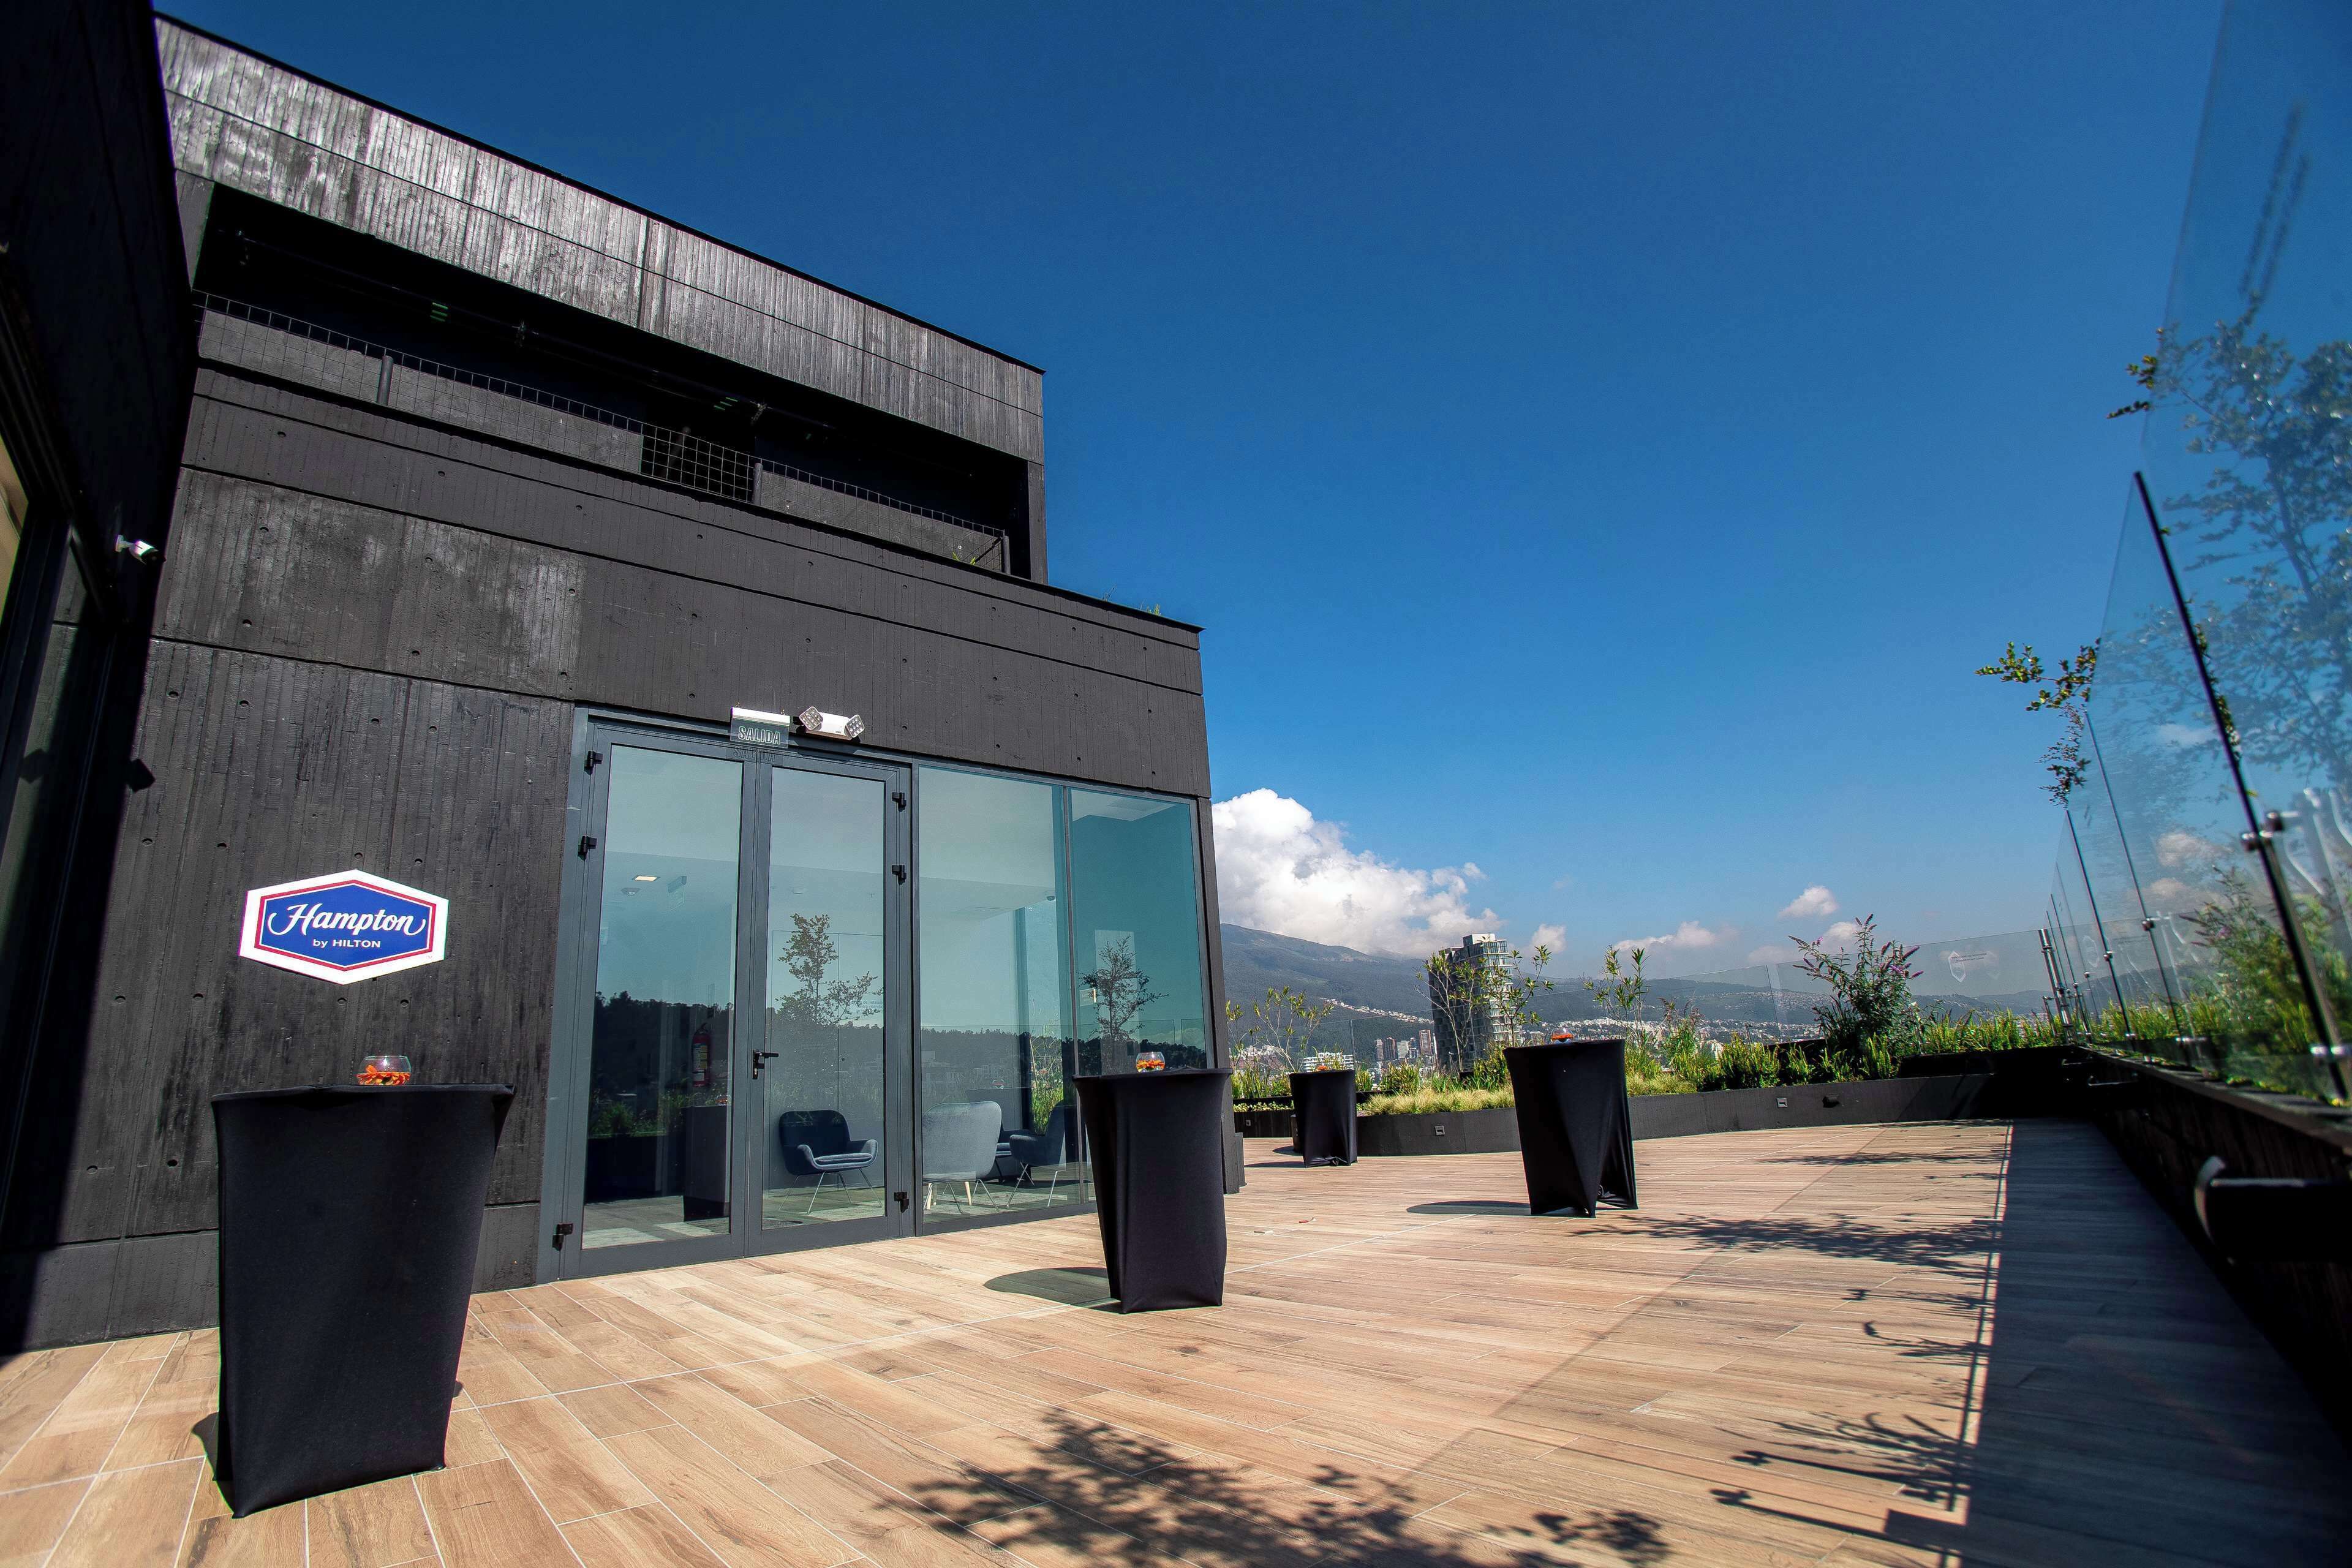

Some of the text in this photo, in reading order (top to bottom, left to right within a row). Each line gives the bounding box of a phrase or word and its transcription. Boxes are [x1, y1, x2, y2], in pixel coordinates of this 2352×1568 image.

[738, 726, 781, 745] SALIDA
[268, 903, 426, 936] Hampton
[313, 938, 381, 948] by HILTON
